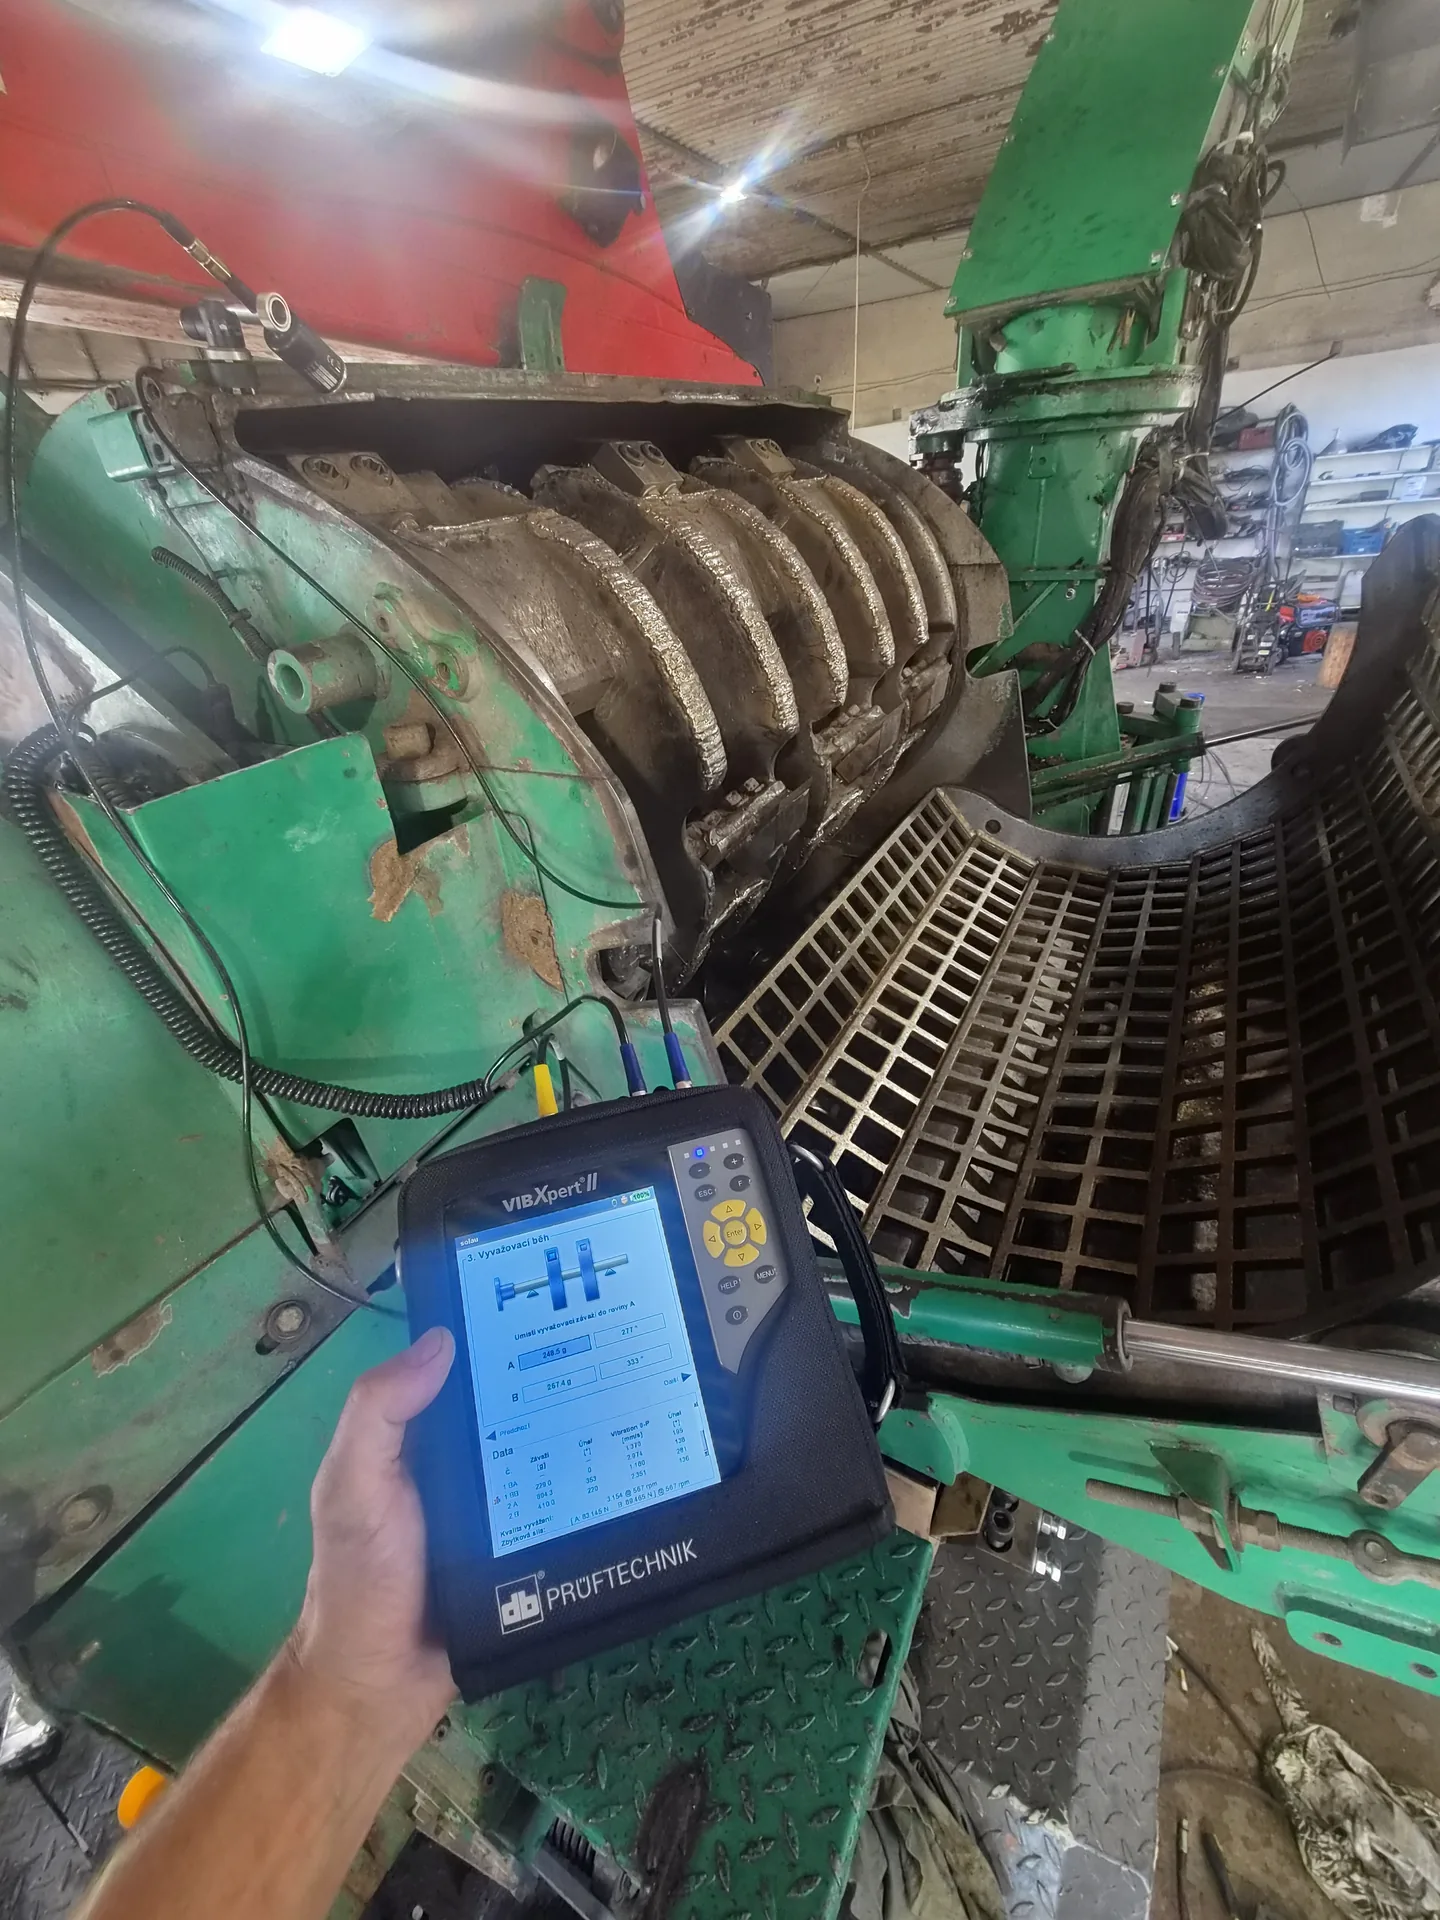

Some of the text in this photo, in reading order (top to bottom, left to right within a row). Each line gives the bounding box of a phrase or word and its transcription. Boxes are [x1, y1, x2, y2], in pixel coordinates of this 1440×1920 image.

[633, 1190, 650, 1200] 100%
[698, 1188, 713, 1198] ESC
[726, 1228, 743, 1238] Enter
[467, 1253, 476, 1262] 3.
[478, 1239, 531, 1260] Vyvažovací
[756, 1270, 775, 1280] MENU
[720, 1280, 738, 1291] HELP
[597, 1309, 607, 1317] do
[608, 1304, 629, 1315] roviny
[629, 1300, 636, 1308] A
[621, 1326, 634, 1336] 277
[507, 1361, 515, 1371] A
[626, 1357, 639, 1367] 333
[512, 1393, 519, 1403] B
[492, 1447, 514, 1460] Data
[646, 1481, 658, 1490] rpm
[678, 1480, 690, 1489] rpm
[546, 1538, 698, 1610] PRÜFTECHNIK
